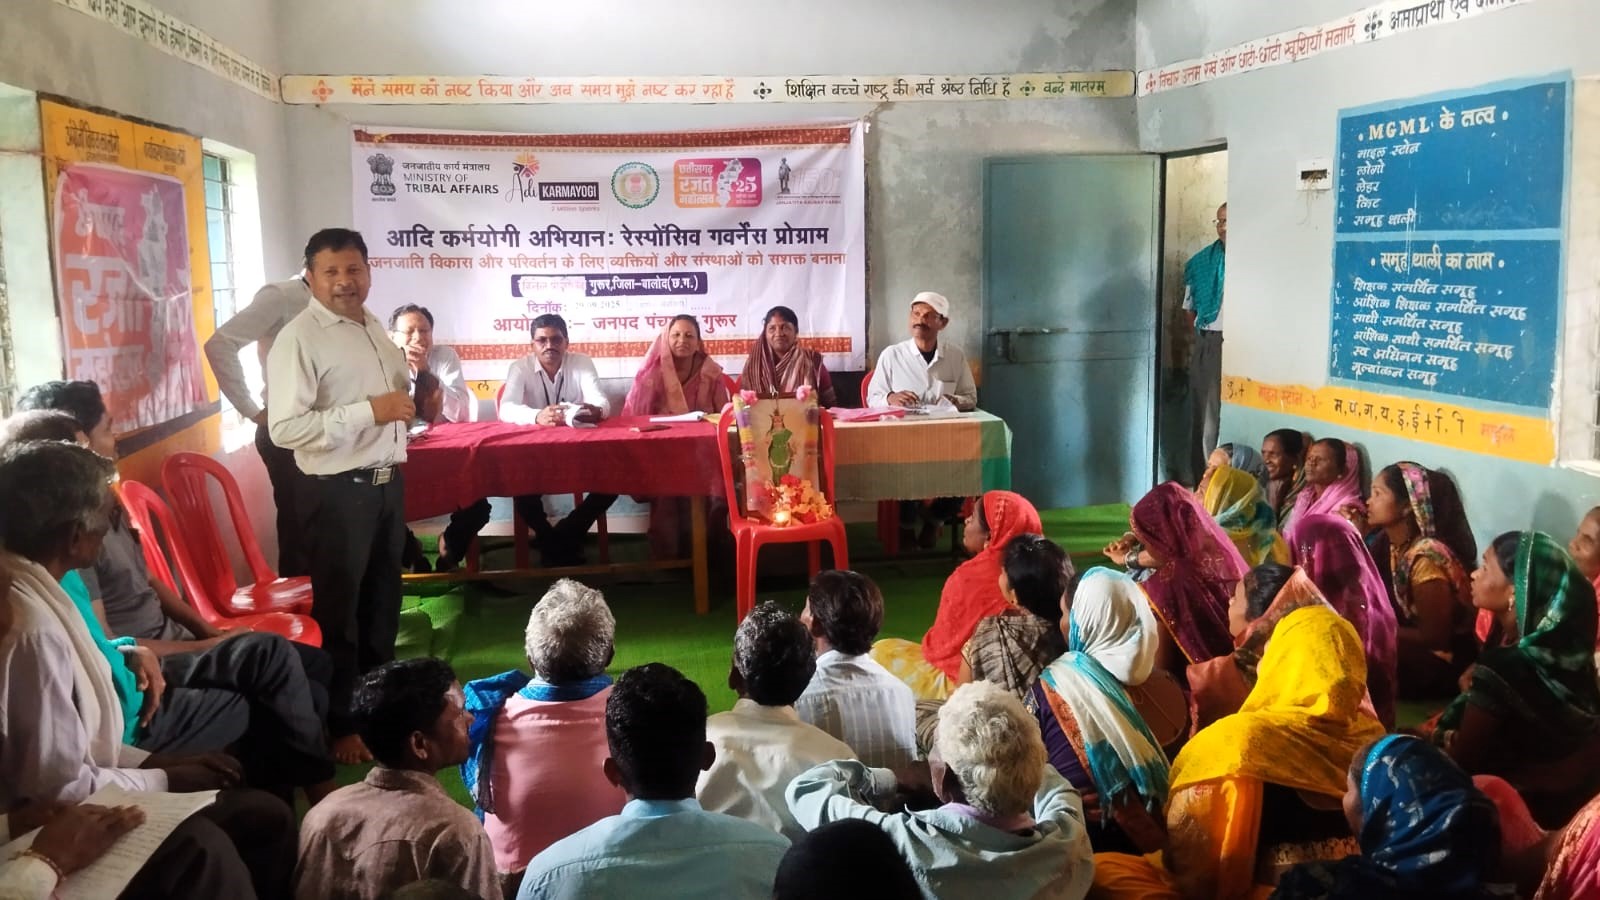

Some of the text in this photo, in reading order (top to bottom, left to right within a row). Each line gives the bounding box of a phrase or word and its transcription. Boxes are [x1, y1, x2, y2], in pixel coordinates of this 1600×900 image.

[382, 83, 415, 97] समय
[420, 78, 439, 97] को
[445, 84, 472, 97] नष्ट
[478, 79, 513, 97] किया
[519, 78, 543, 97] और
[580, 83, 611, 97] समय
[642, 83, 669, 97] नष्ट
[674, 84, 696, 97] कर
[702, 84, 722, 100] रहा
[785, 79, 826, 100] शिक्षित
[893, 78, 909, 96] की
[915, 77, 935, 97] सर्व
[941, 78, 965, 96] श्रेष्ठ
[968, 77, 997, 96] निधि
[1070, 80, 1106, 95] मातरम्
[1439, 106, 1456, 130] के
[1357, 138, 1421, 160] माइल स्टोन
[402, 161, 490, 171] जनजातीय कार्य मंत्रालय
[1356, 159, 1386, 176] लोगो
[403, 173, 469, 183] MINISTRY OF
[405, 183, 499, 194] TRIBAL AFFAIRS
[505, 173, 537, 203] Adi
[678, 176, 714, 192] रजत
[735, 176, 757, 193] 25
[542, 185, 597, 198] KARMAYOGI
[1353, 215, 1385, 228] समूह
[387, 224, 434, 247] आदि
[440, 224, 520, 247] कर्मयोगी
[620, 223, 701, 246] रेस्पोंसिव
[773, 221, 829, 245] प्रोग्राम
[370, 250, 846, 270] जनजाति विकास और परिवर्तन के लिए व्यक्तियों और संस्थाओं को सशक्त बनाना
[1380, 244, 1495, 271] समूह थाली का नाम
[1353, 277, 1478, 299] शिक्षक समर्थित समूह
[1352, 294, 1390, 308] आंशिक
[1435, 299, 1487, 315] समर्थित
[1489, 305, 1528, 321] समूह
[592, 316, 639, 330] जनपद
[702, 314, 737, 334] गुरूर
[1382, 312, 1427, 328] समर्थित
[1428, 320, 1464, 334] समूह
[1353, 328, 1389, 343] आंशिक
[1422, 335, 1473, 352] समर्थित
[1474, 342, 1515, 361] समूह
[1373, 345, 1425, 365] अधिगम
[1425, 354, 1459, 371] समूह
[1406, 368, 1439, 385] समूह
